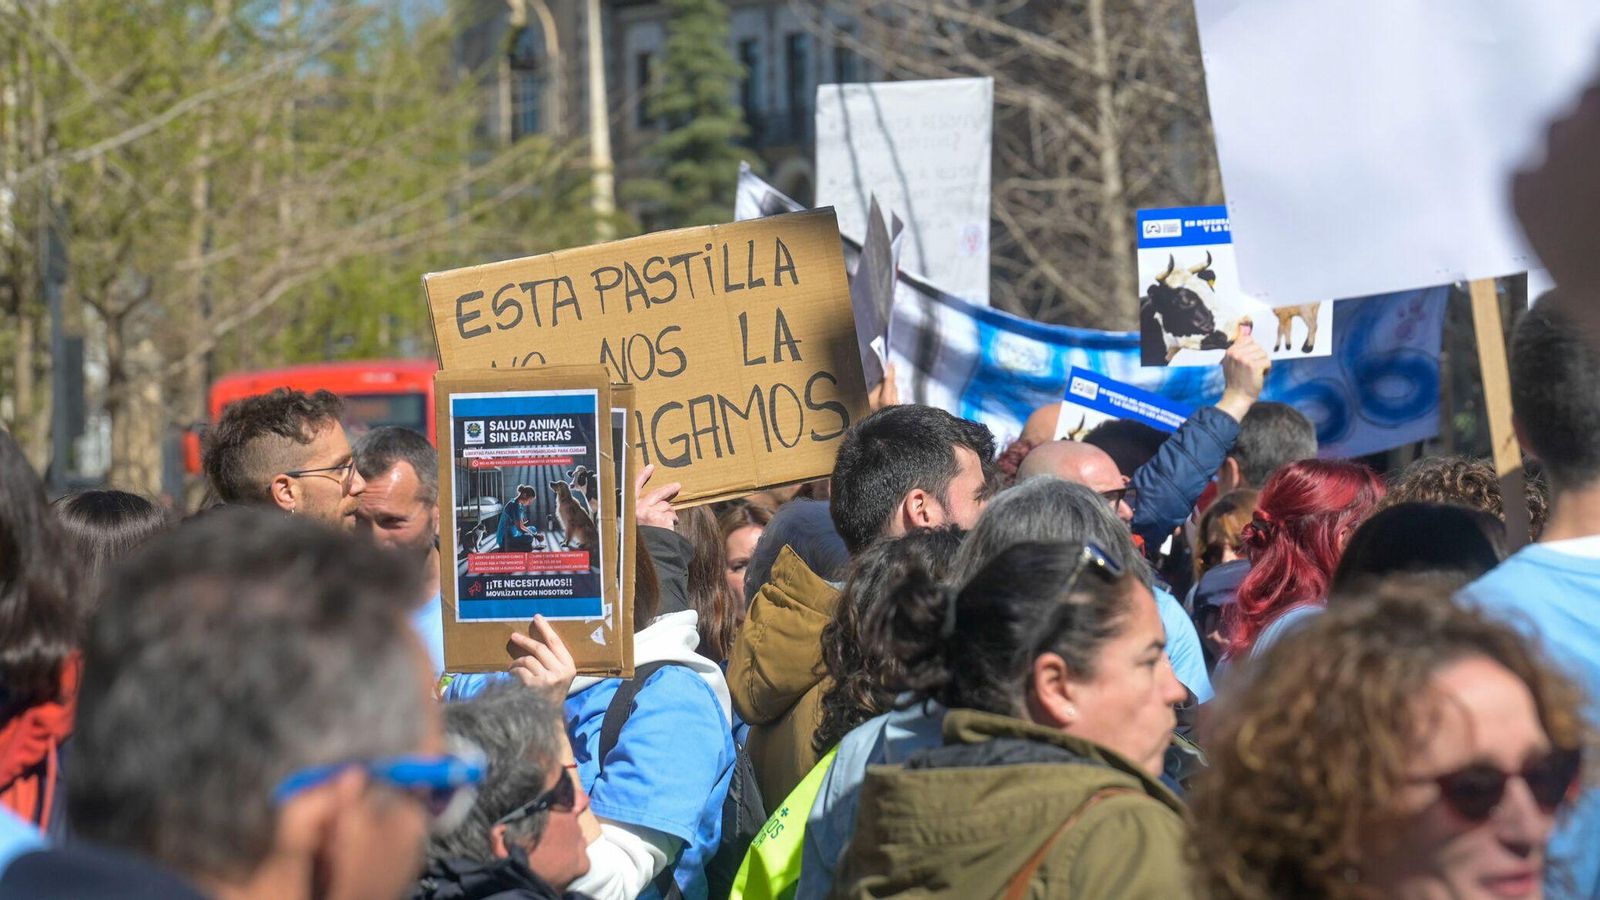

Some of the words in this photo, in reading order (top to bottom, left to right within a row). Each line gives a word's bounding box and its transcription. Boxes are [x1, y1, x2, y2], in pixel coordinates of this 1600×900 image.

[456, 275, 582, 339] ESTA
[600, 325, 687, 382] NOS
[739, 307, 802, 366] LA
[489, 420, 526, 431] SALUD
[529, 418, 575, 430] ANIMAL
[634, 371, 850, 468] AGAMOS
[489, 432, 508, 442] SIN
[511, 430, 572, 442] BARRERAS
[504, 578, 572, 588] NECESITAMOS!!
[486, 589, 522, 597] MOVILÍZATE
